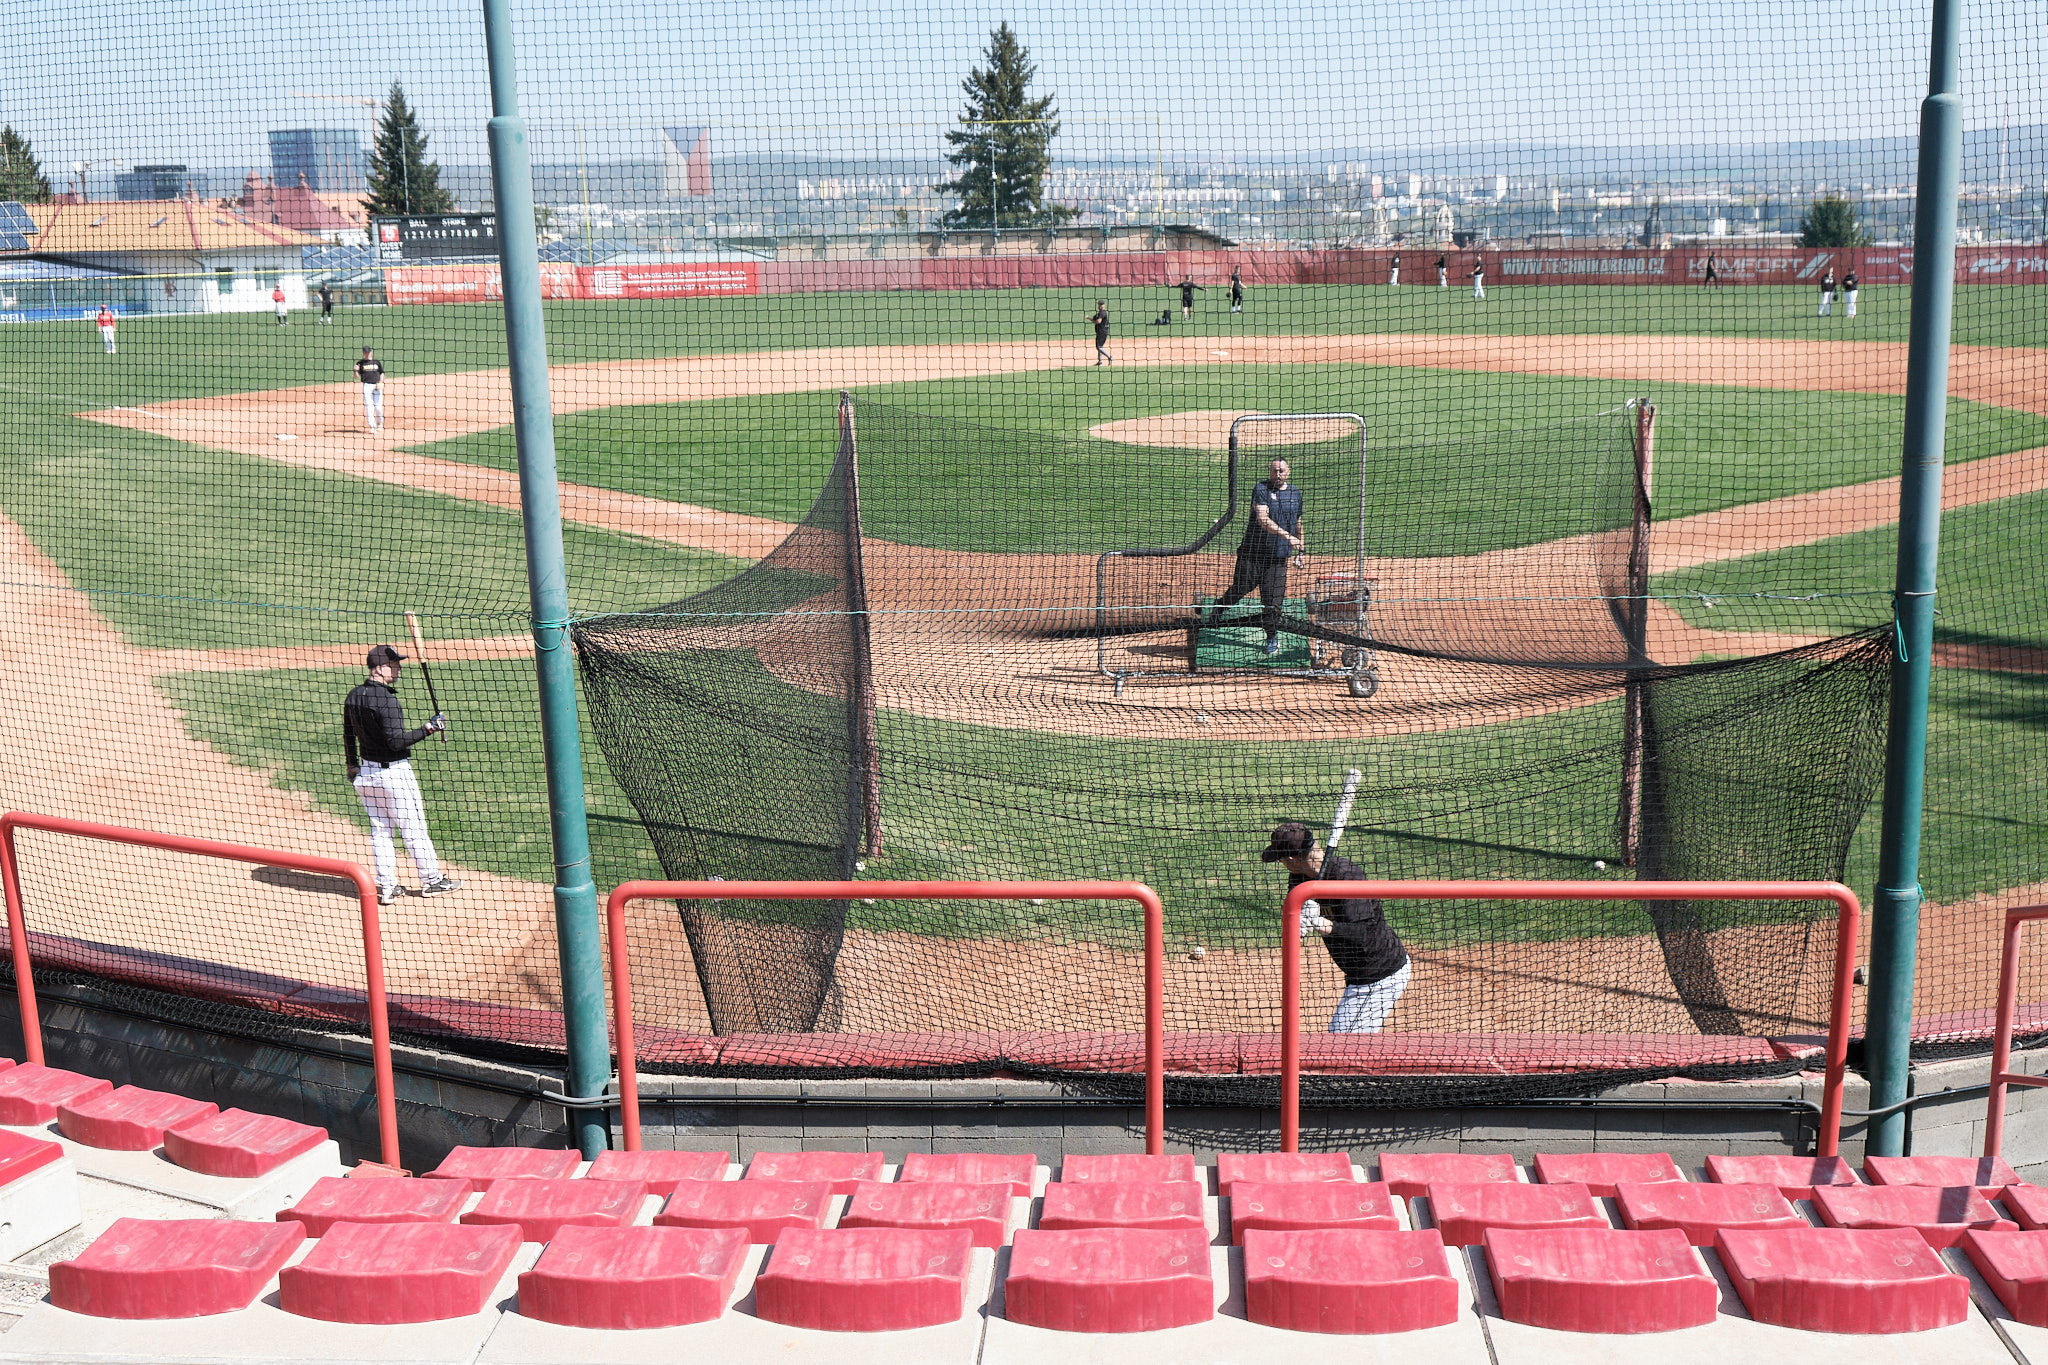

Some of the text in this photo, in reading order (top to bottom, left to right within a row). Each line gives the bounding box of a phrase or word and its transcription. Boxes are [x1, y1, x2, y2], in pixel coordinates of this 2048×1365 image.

[409, 219, 428, 228] BALL
[442, 218, 466, 226] STRIKE
[486, 227, 494, 237] R
[380, 242, 403, 250] GUEST
[382, 251, 402, 259] HOME
[1502, 257, 1666, 275] WWW.TECHNIKABRNO.CZ
